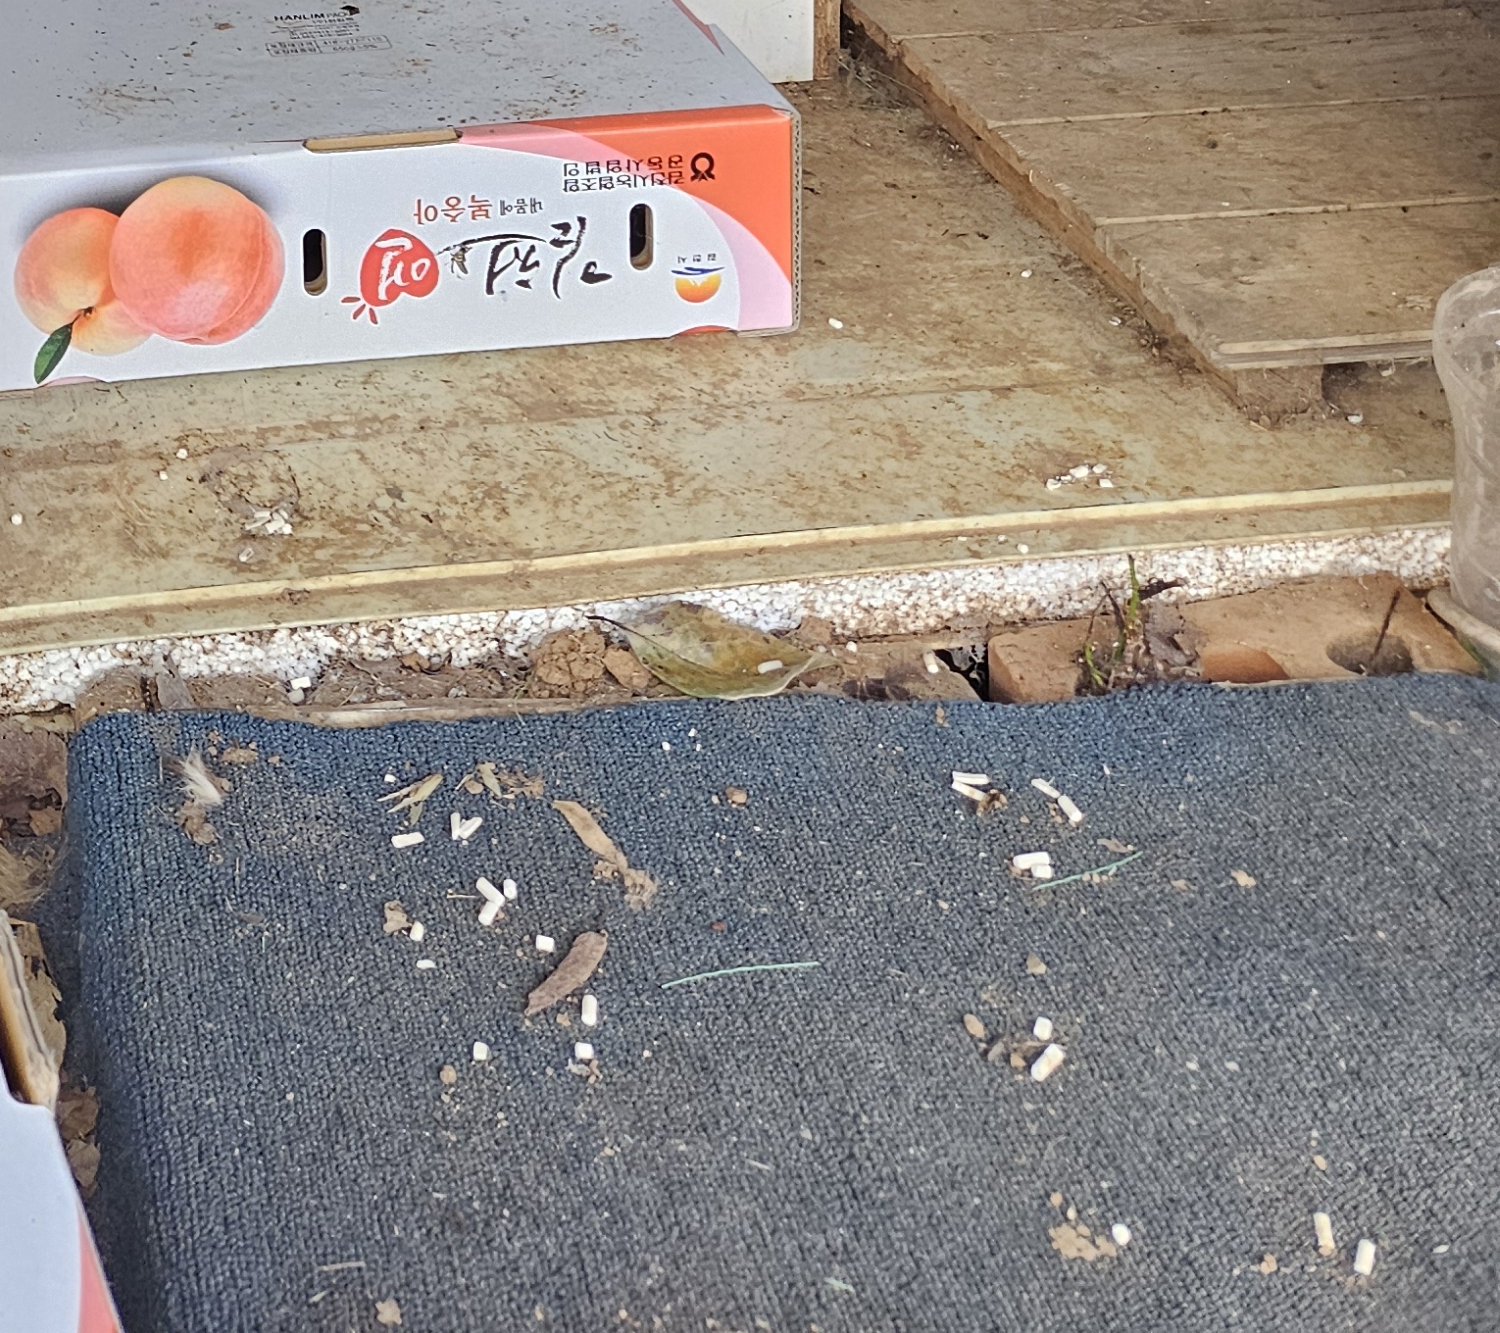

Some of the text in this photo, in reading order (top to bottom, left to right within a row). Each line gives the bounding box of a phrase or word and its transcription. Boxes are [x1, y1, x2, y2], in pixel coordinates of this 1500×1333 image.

[274, 13, 325, 22] HANLIM
[413, 195, 543, 225] 내몸에 복숭아
